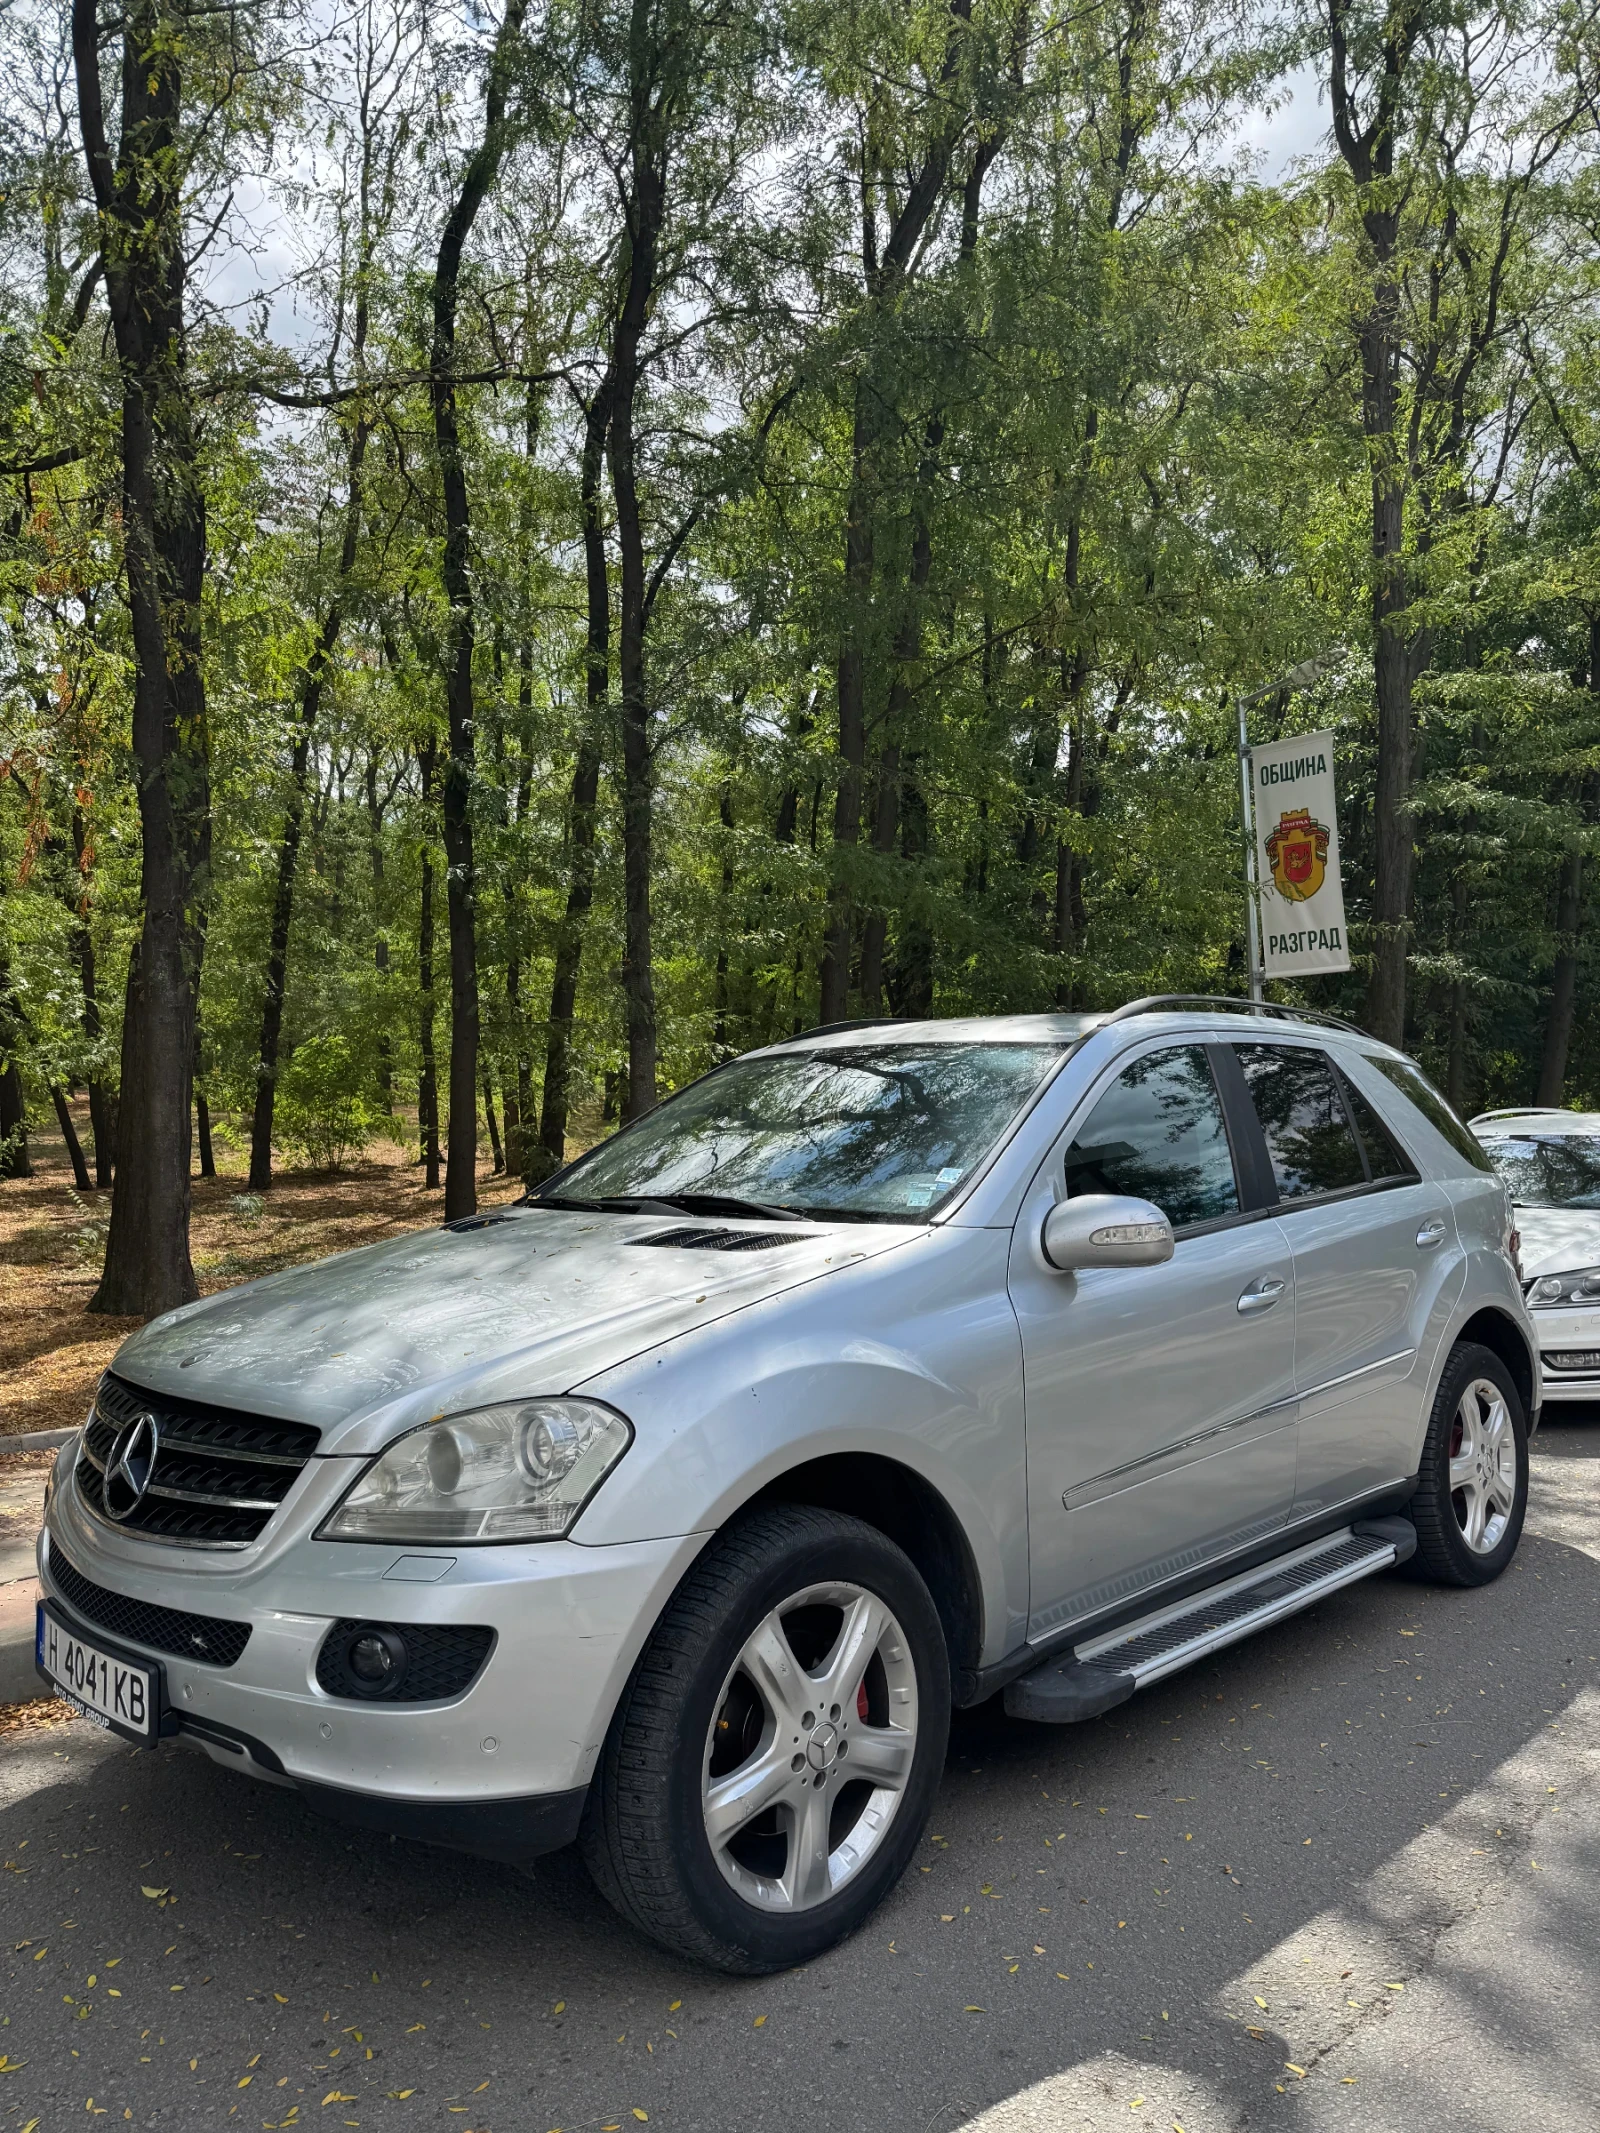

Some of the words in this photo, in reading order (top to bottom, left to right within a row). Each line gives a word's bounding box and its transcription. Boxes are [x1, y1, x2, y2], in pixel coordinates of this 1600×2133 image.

[1260, 754, 1327, 787] ОБЩИНА
[1269, 927, 1342, 956] РАЗГРАД
[65, 1640, 108, 1707] 4041
[53, 1682, 67, 1701] AUTO
[67, 1695, 85, 1714] DEMO
[85, 1708, 110, 1729] GROUP
